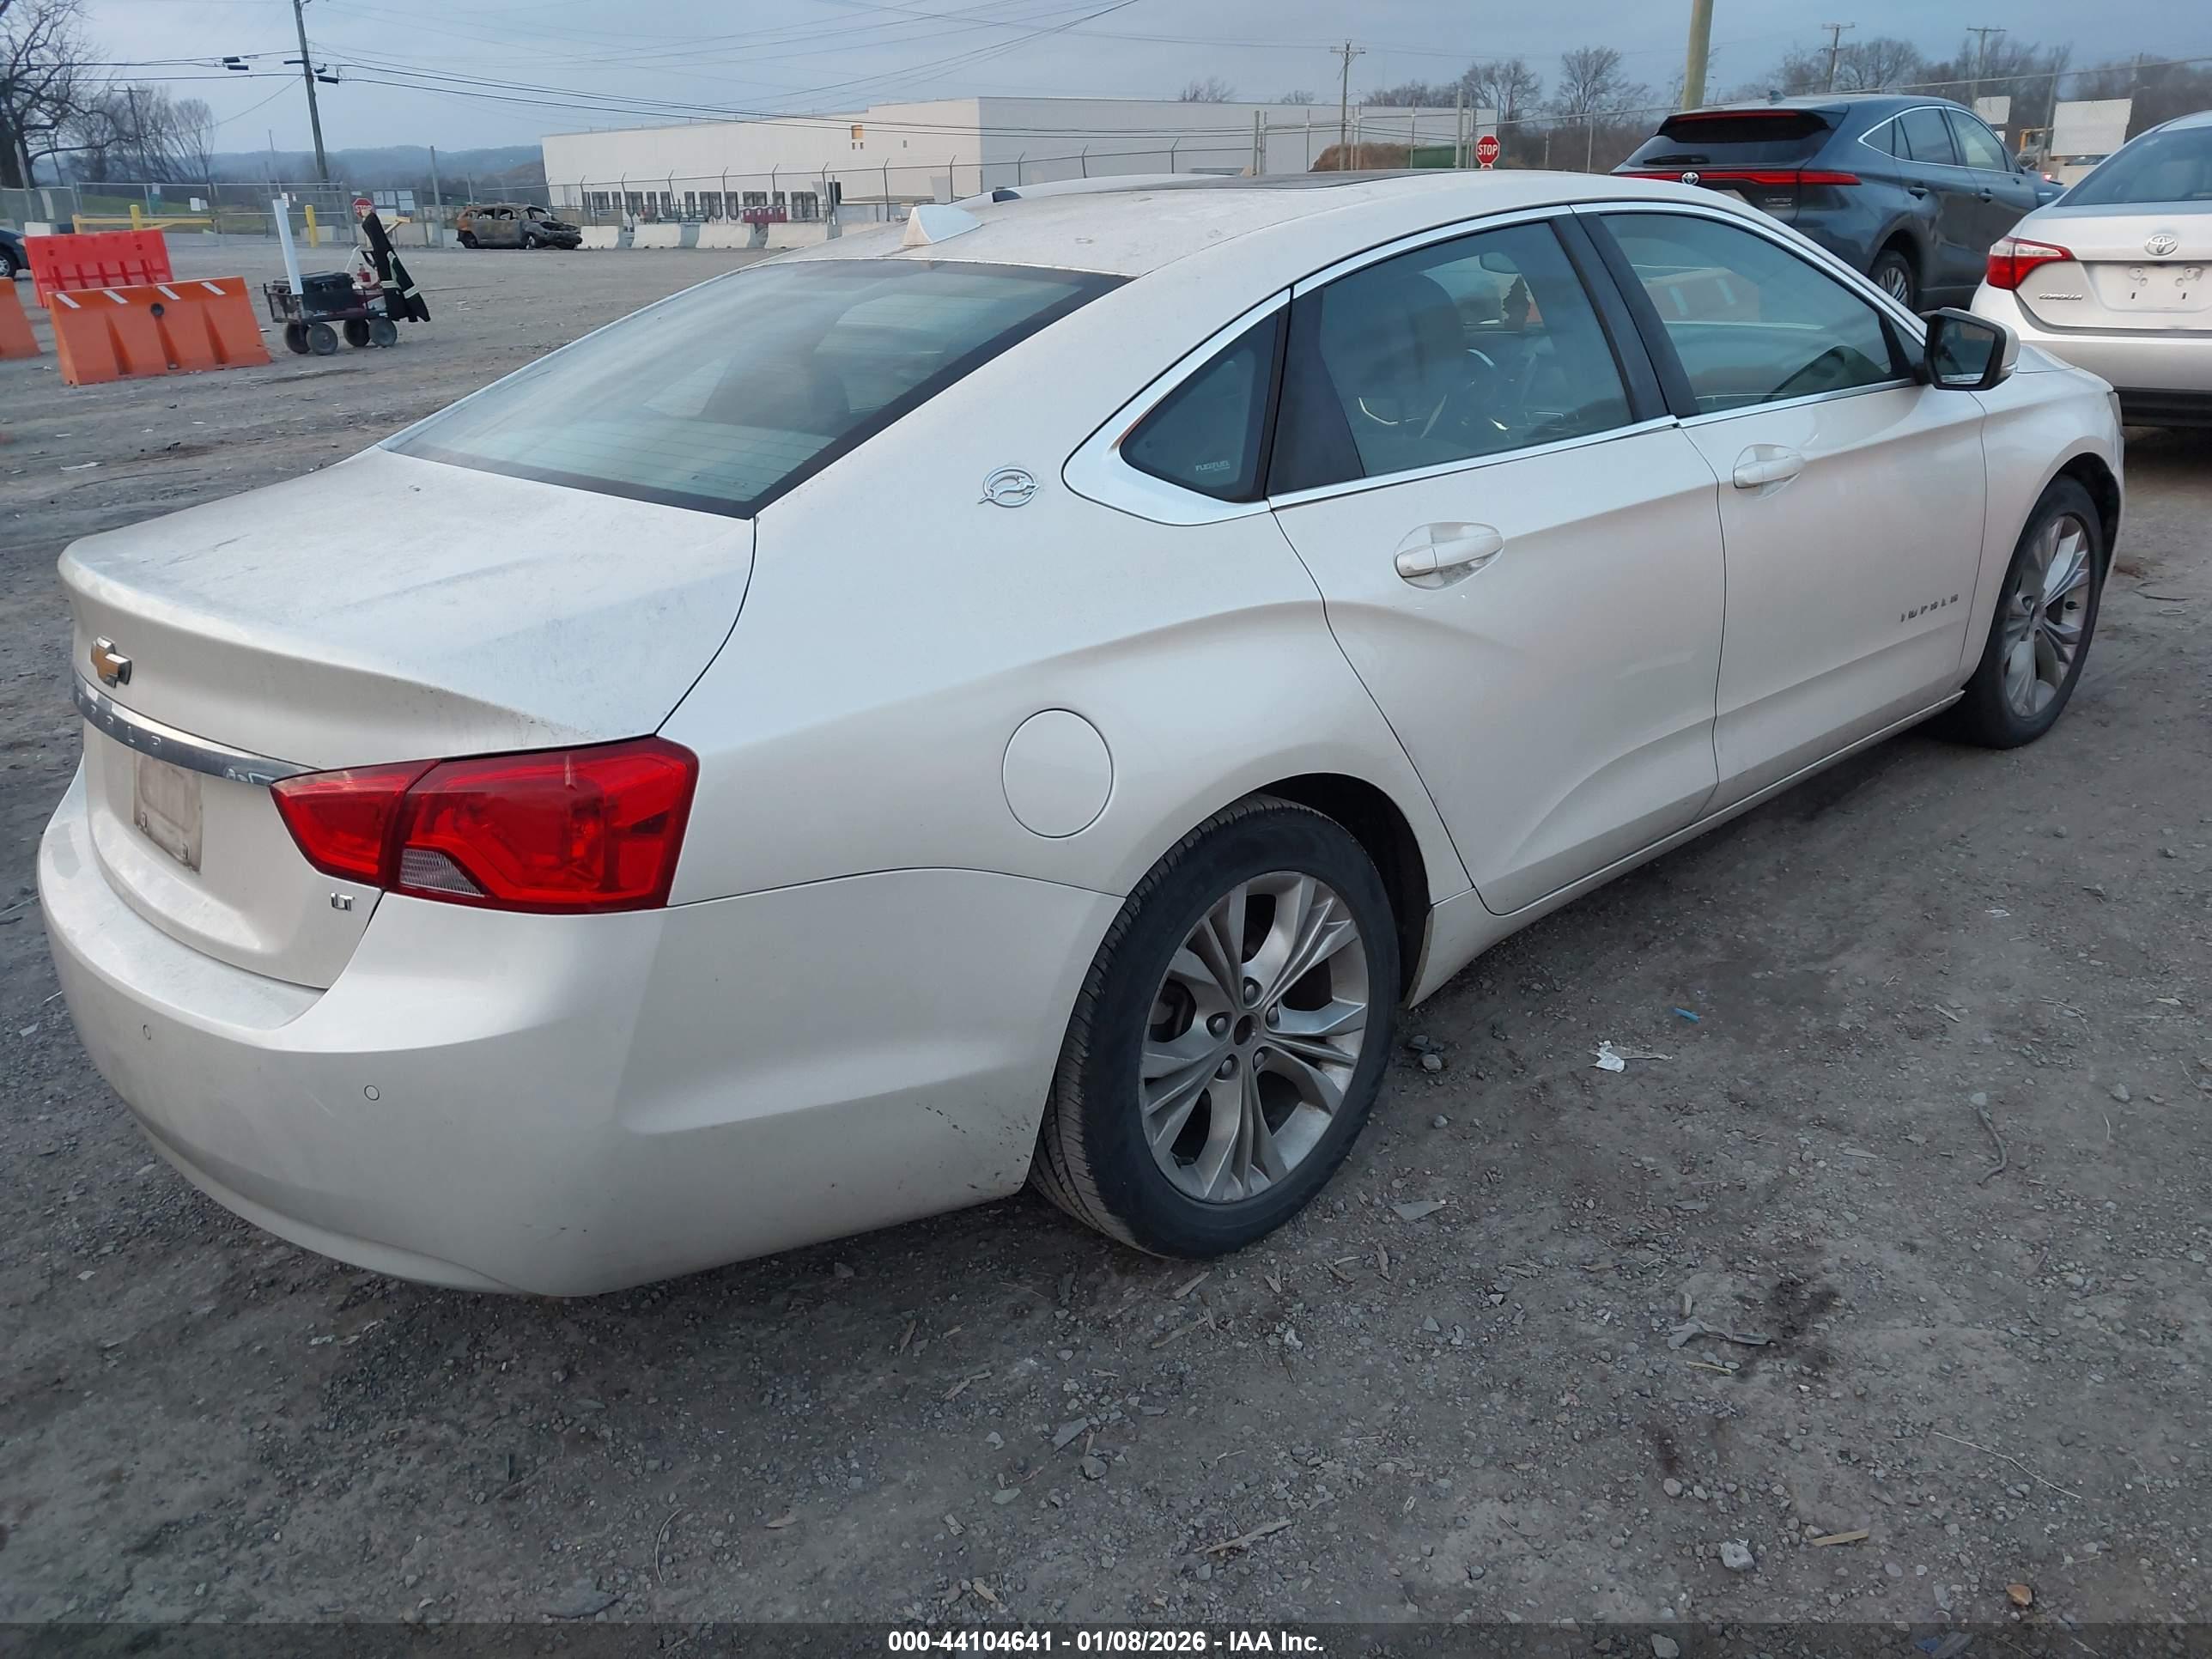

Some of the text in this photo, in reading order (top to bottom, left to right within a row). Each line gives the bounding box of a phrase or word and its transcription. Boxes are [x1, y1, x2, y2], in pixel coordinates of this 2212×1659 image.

[1478, 144, 1498, 155] STOP
[1900, 593, 1959, 623] IMPALA
[330, 892, 354, 912] LT
